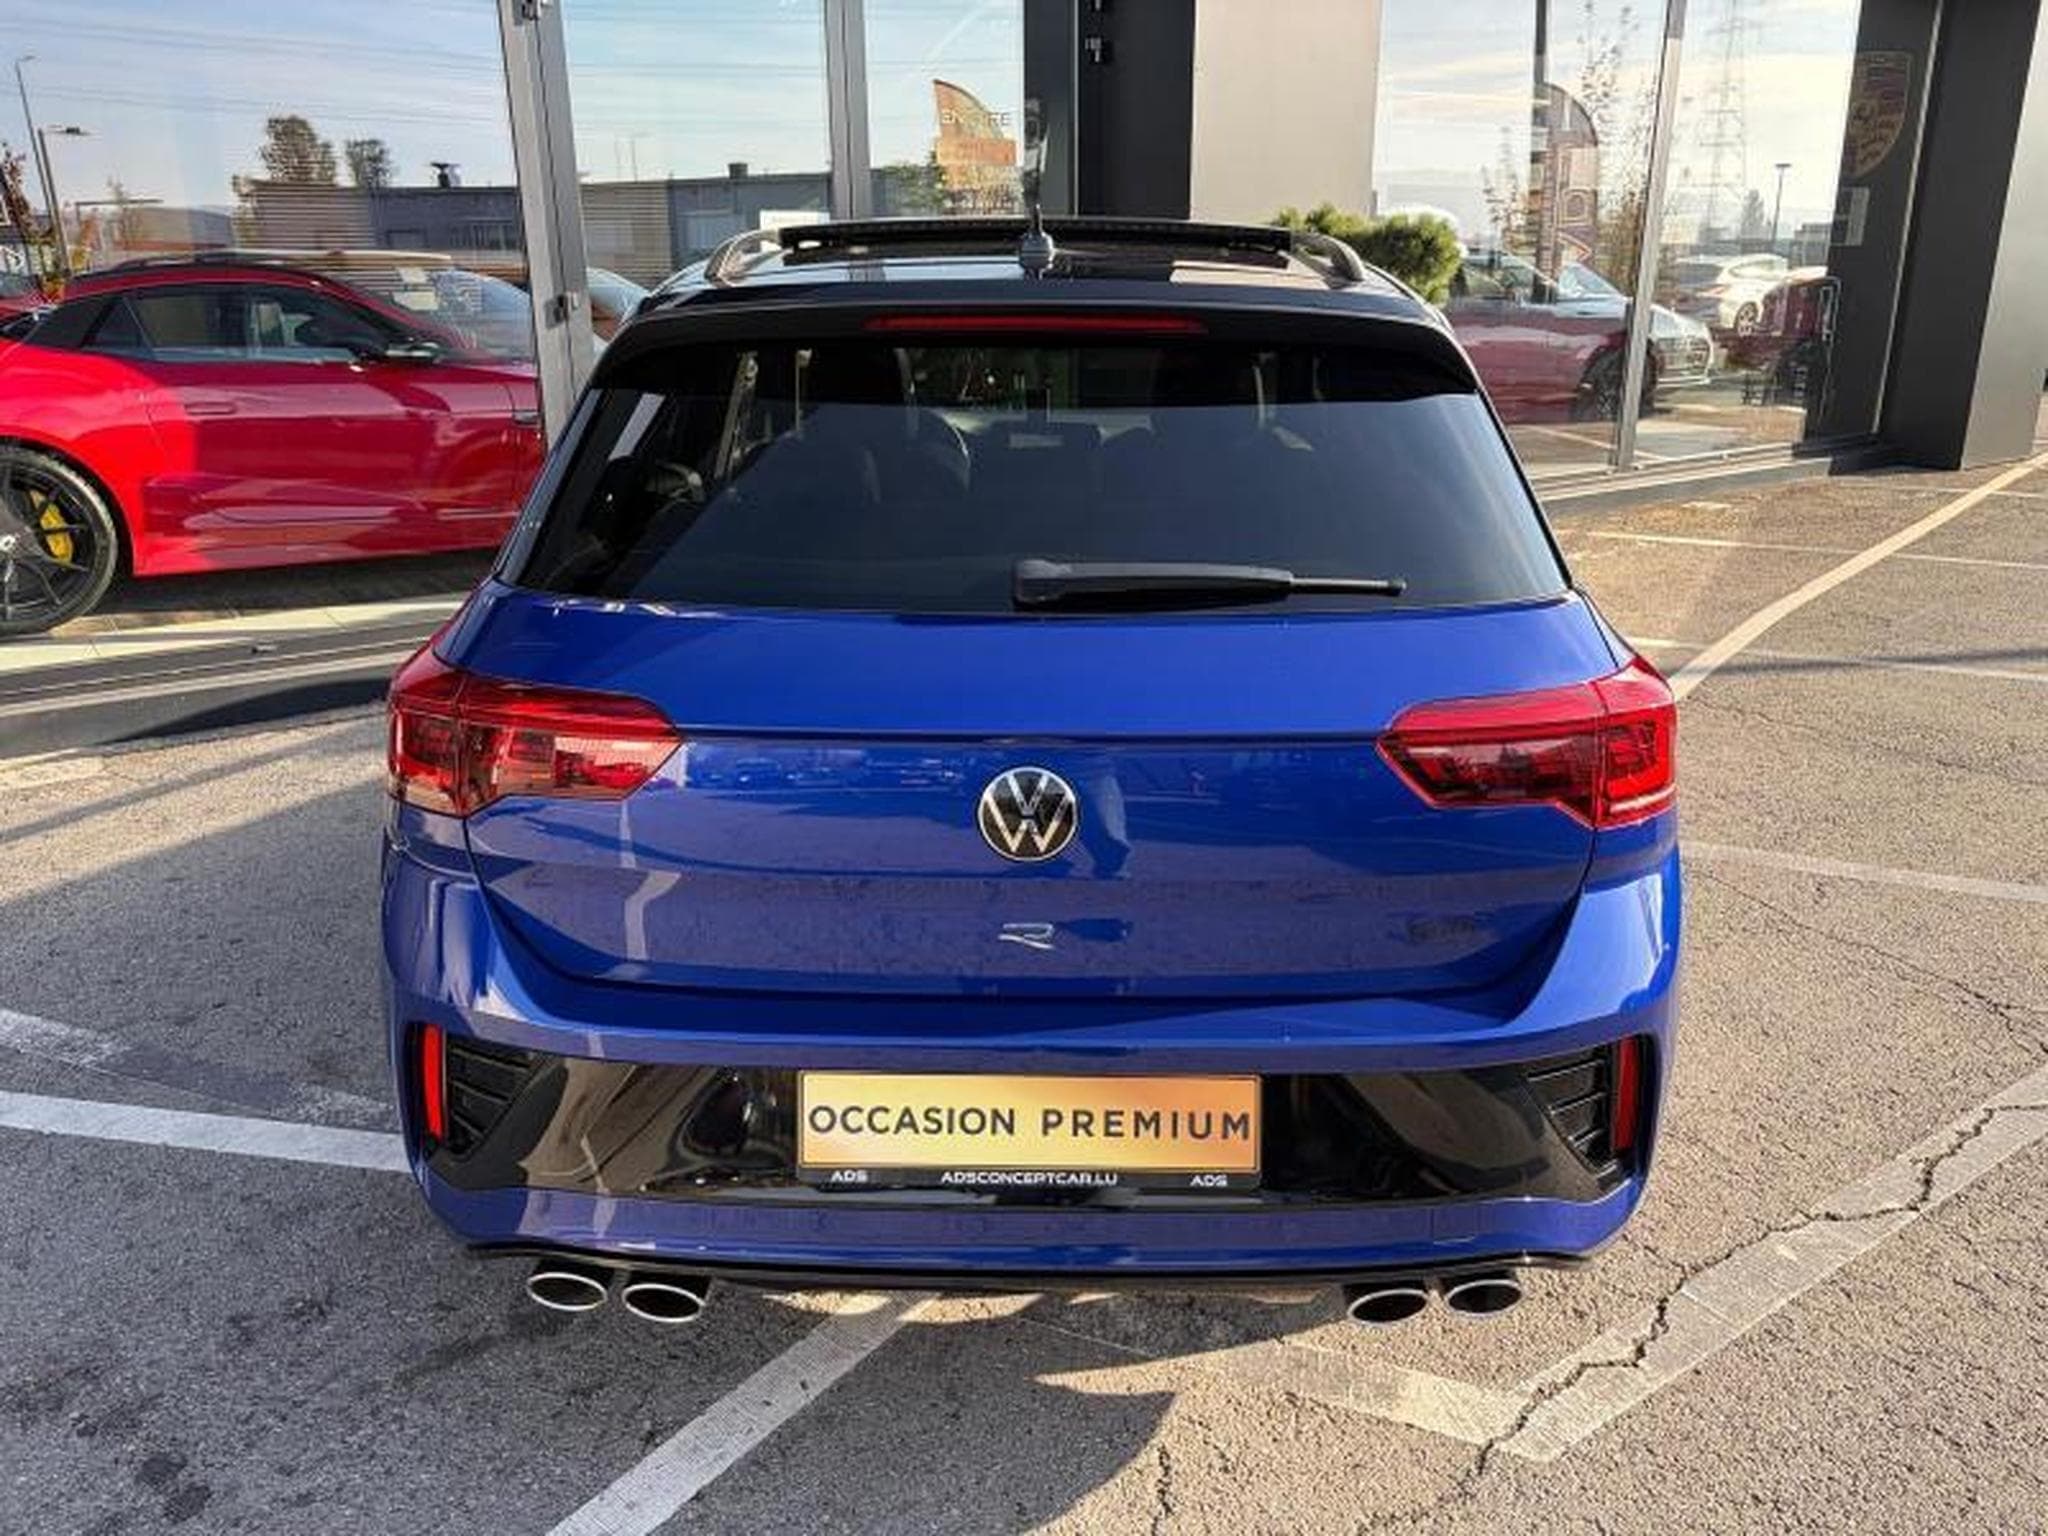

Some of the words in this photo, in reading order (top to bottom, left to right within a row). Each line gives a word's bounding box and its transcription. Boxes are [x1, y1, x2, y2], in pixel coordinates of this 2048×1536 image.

[809, 1105, 1015, 1136] OCCASION
[1041, 1108, 1250, 1141] PREMIUM
[830, 1169, 868, 1183] ADS
[940, 1171, 1118, 1186] ADSCONCEPTCAR.LU
[1189, 1174, 1228, 1187] ADS
